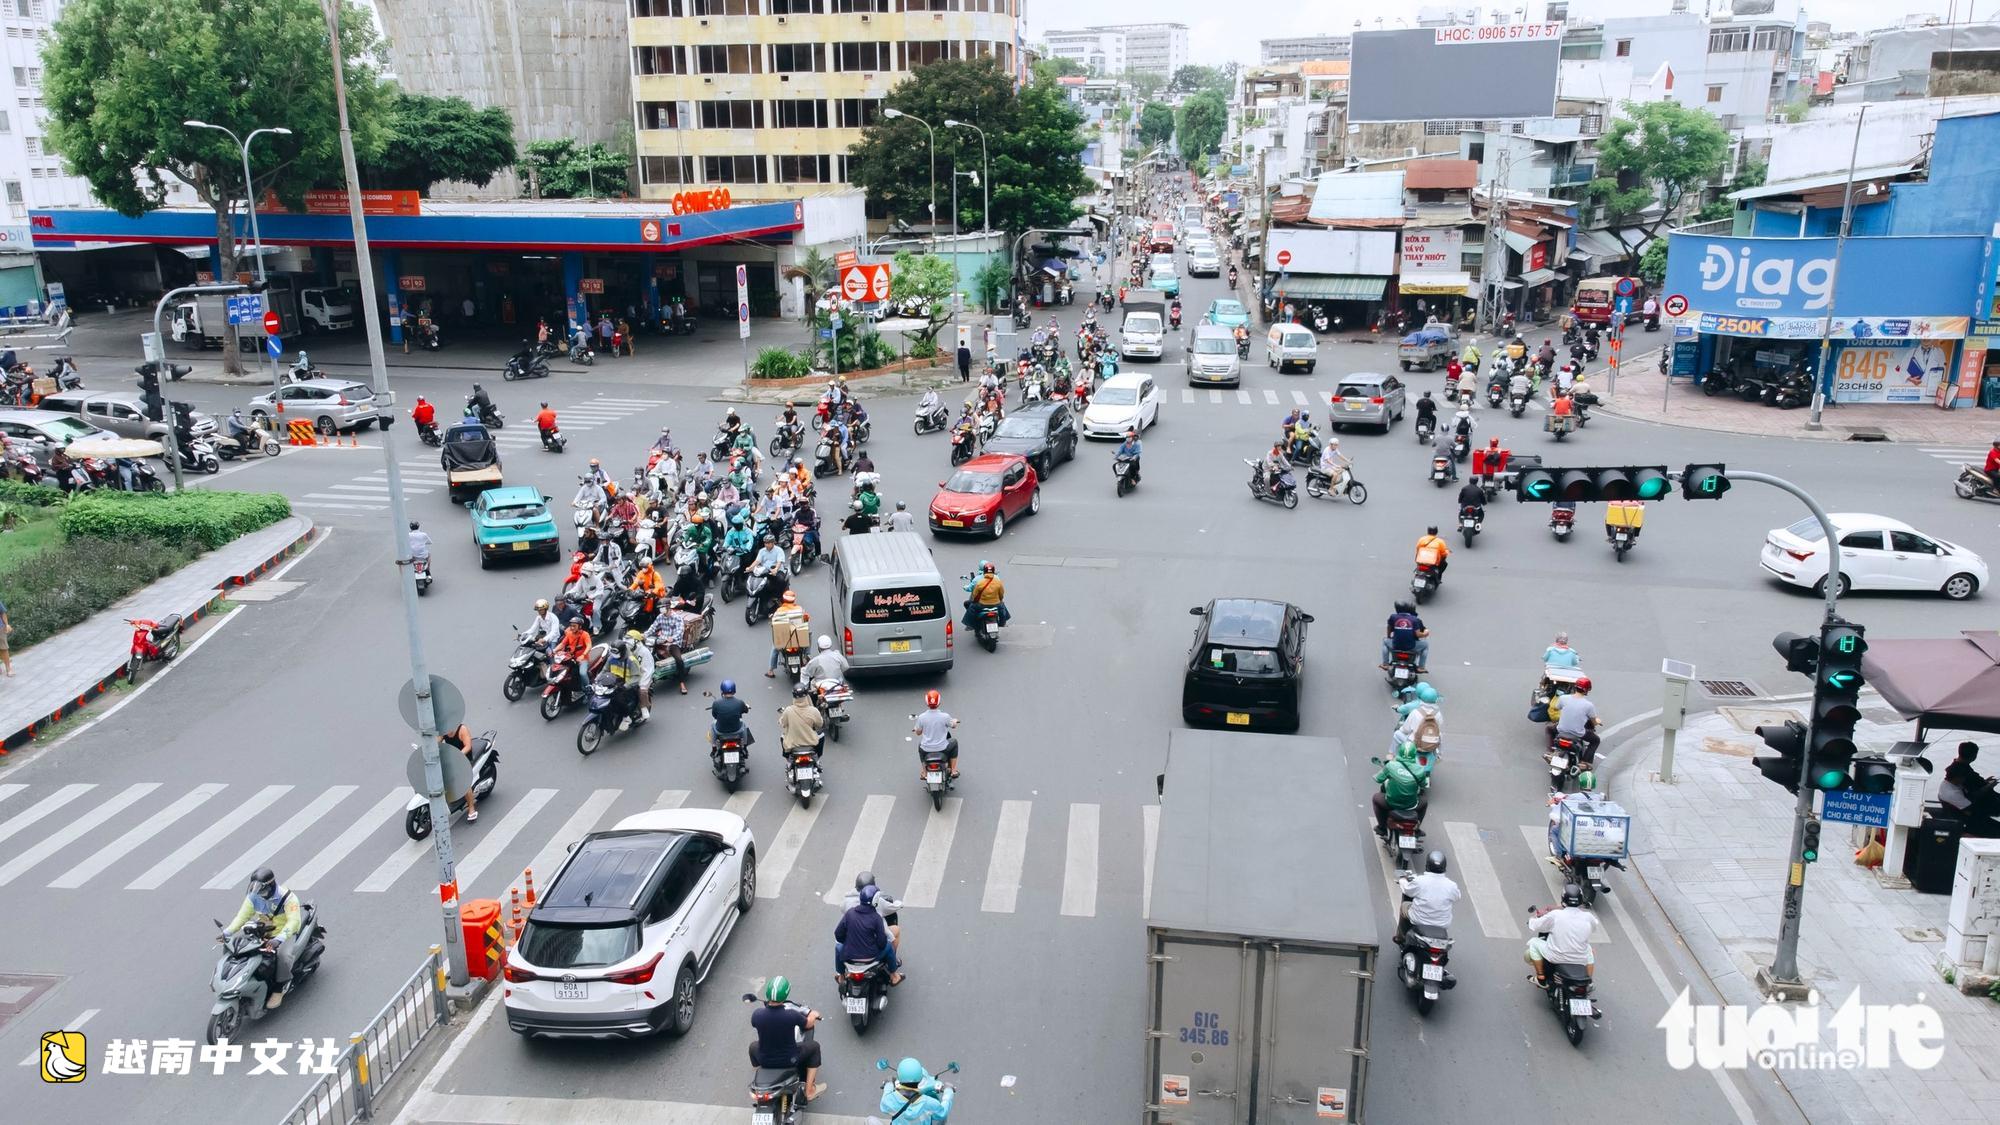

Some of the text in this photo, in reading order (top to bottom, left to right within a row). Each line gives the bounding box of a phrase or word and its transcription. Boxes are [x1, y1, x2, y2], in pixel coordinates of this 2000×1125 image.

[1436, 24, 1560, 42] LHQC: 0906 57 57 57
[1405, 234, 1419, 242] RỬA
[1716, 317, 1765, 335] 250K
[1840, 350, 1889, 380] 846
[1838, 382, 1850, 390] 23
[1826, 810, 1841, 819] CHO
[1842, 812, 1852, 821] XE
[1193, 1011, 1219, 1028] 61C
[1179, 1028, 1229, 1047] 345.86
